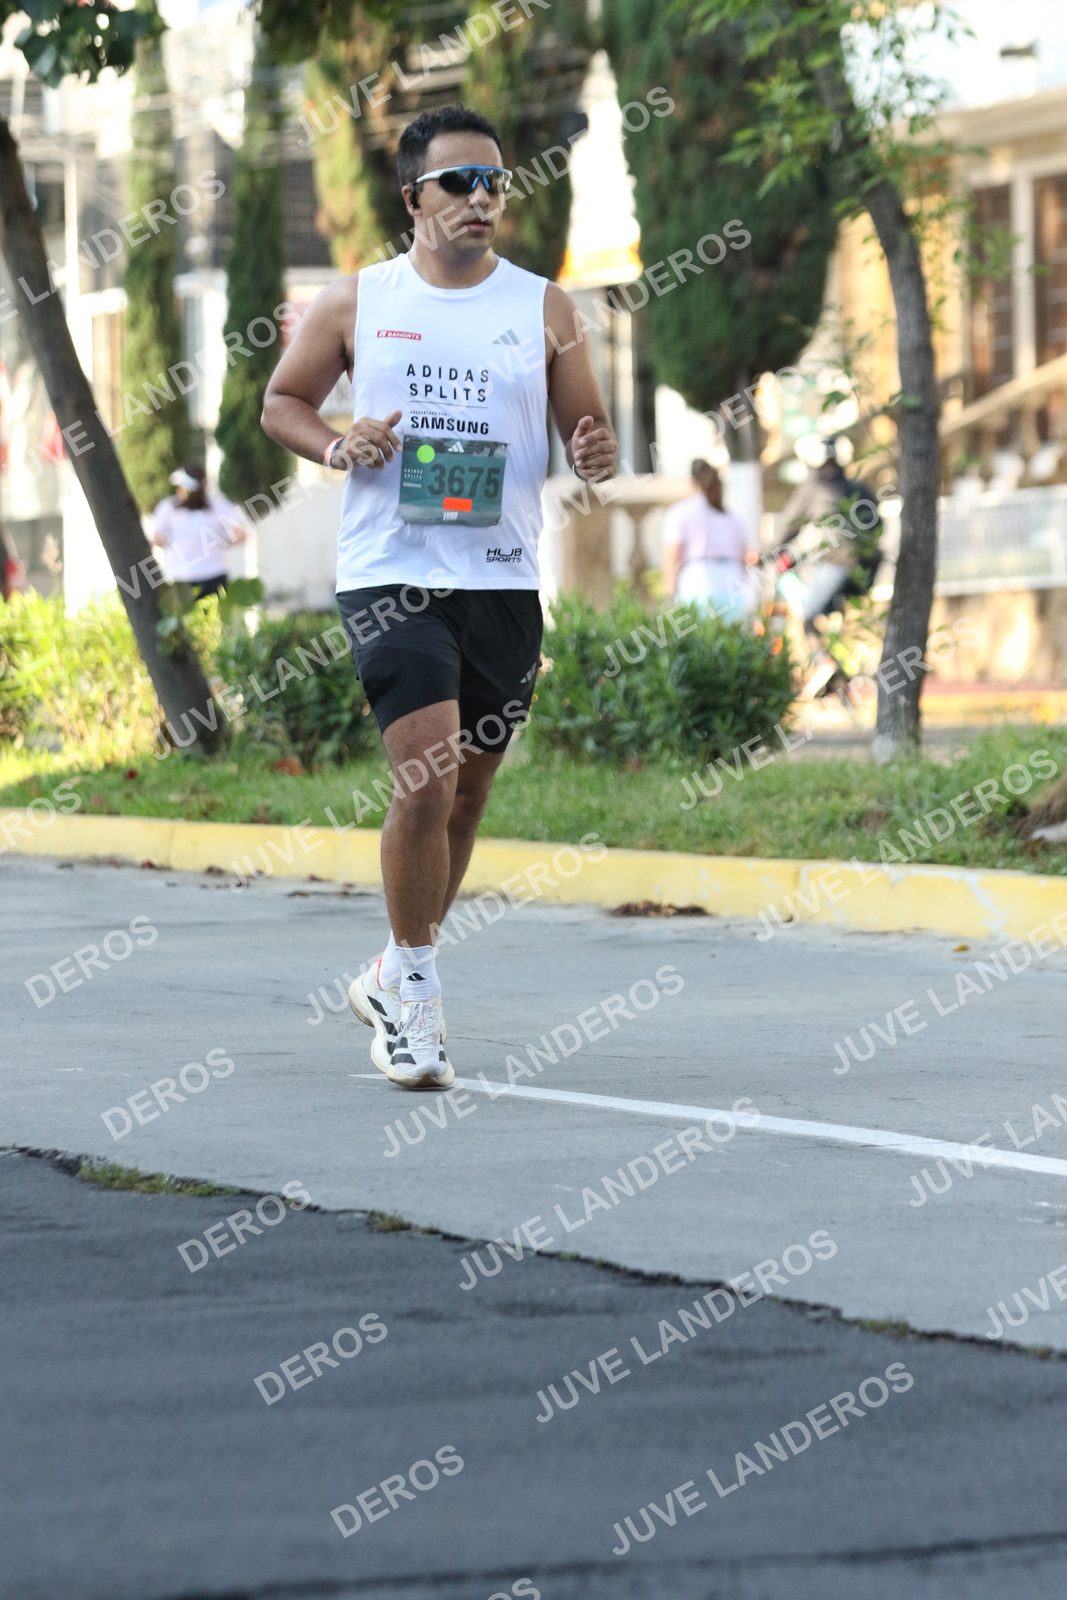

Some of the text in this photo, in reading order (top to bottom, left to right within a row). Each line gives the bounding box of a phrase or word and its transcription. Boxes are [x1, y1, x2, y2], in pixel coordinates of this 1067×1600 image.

[406, 363, 489, 383] ADIDAS
[409, 383, 486, 402] SPLITS
[410, 415, 489, 435] SAMSUNG
[427, 463, 500, 499] 3675
[486, 548, 522, 557] HUB
